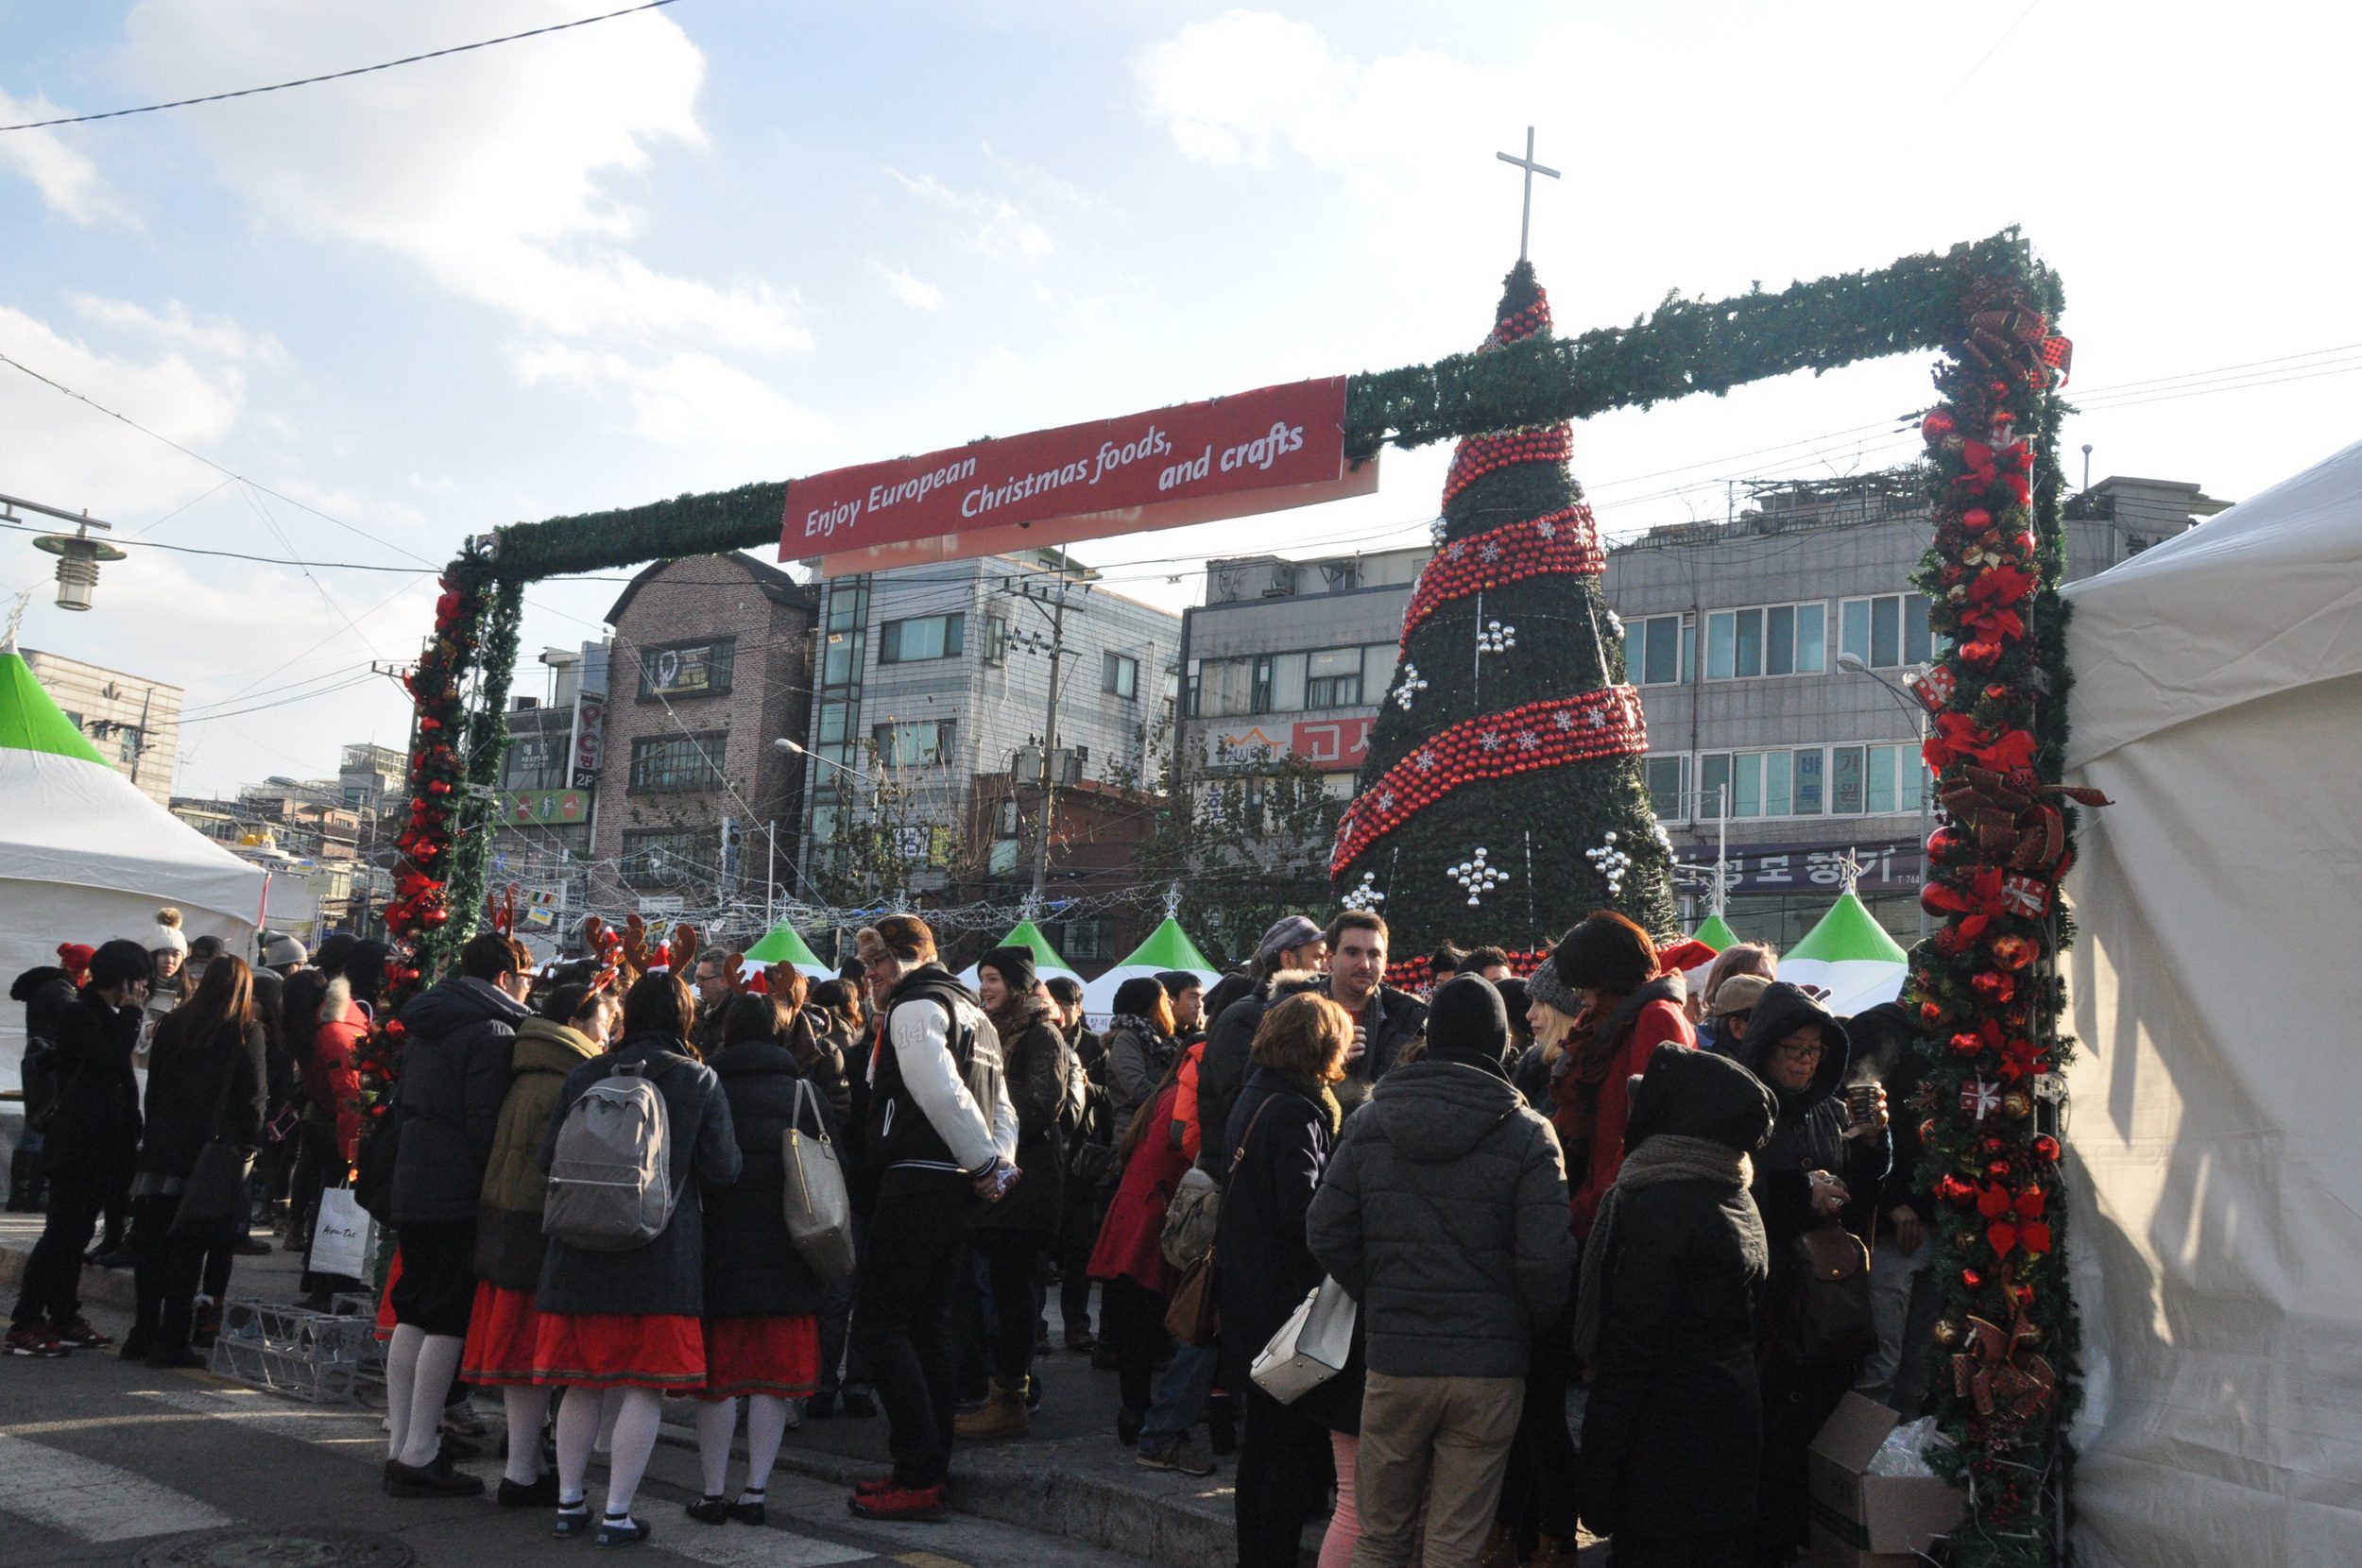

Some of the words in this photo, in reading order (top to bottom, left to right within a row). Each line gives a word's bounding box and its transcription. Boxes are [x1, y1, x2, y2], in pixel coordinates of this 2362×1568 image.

[961, 458, 1088, 519] Christmas
[1088, 425, 1172, 485] foods,
[1158, 444, 1212, 491] and
[1220, 421, 1304, 472] crafts
[805, 499, 862, 537] Enjoy
[867, 456, 977, 513] European
[576, 773, 594, 787] 2F
[898, 1018, 926, 1049] 14
